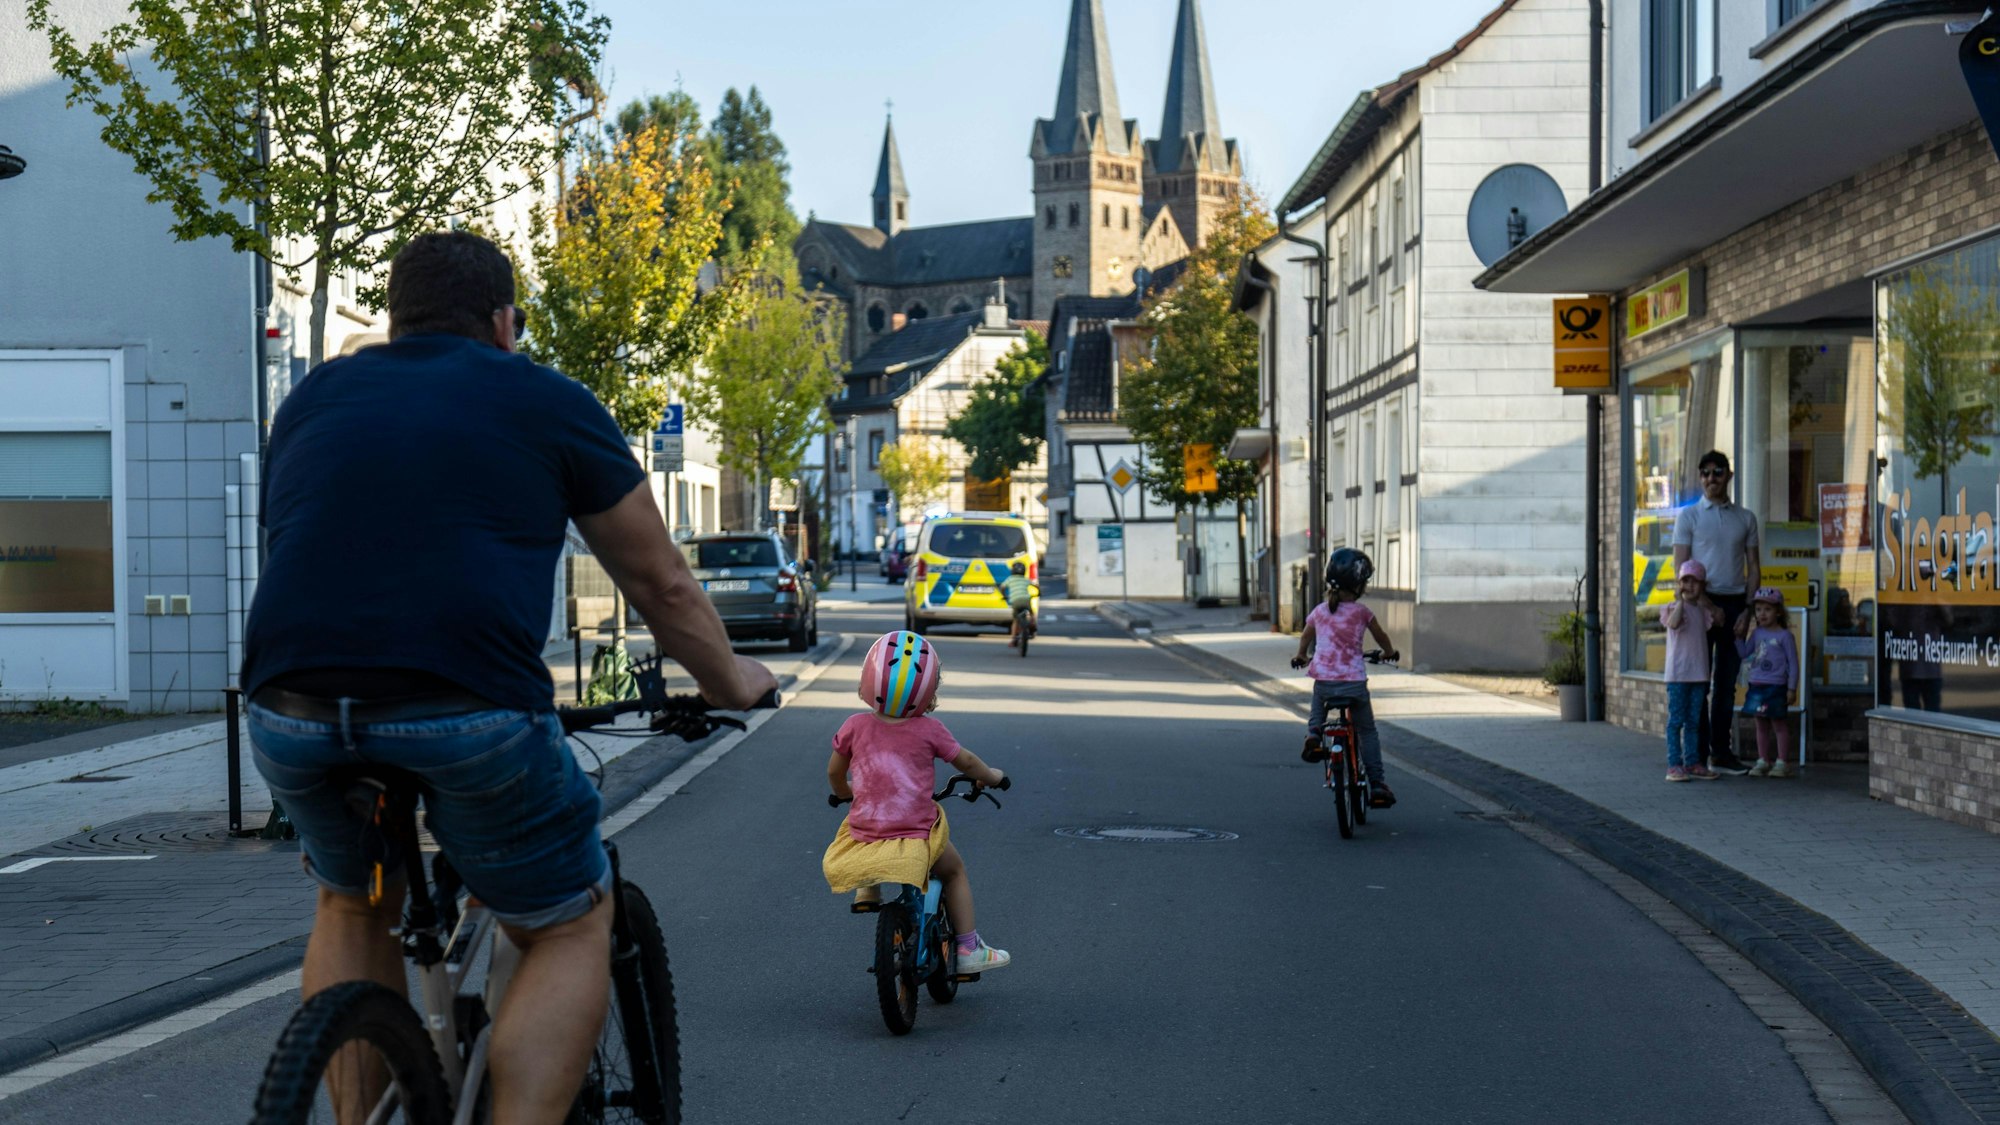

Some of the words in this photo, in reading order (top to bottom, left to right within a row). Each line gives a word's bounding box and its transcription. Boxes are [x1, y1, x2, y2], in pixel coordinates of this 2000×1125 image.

[1563, 364, 1601, 373] DHL
[1884, 631, 1919, 661] Pizzeria
[1924, 632, 1978, 666] Restaurant
[1985, 637, 2000, 667] Ca
